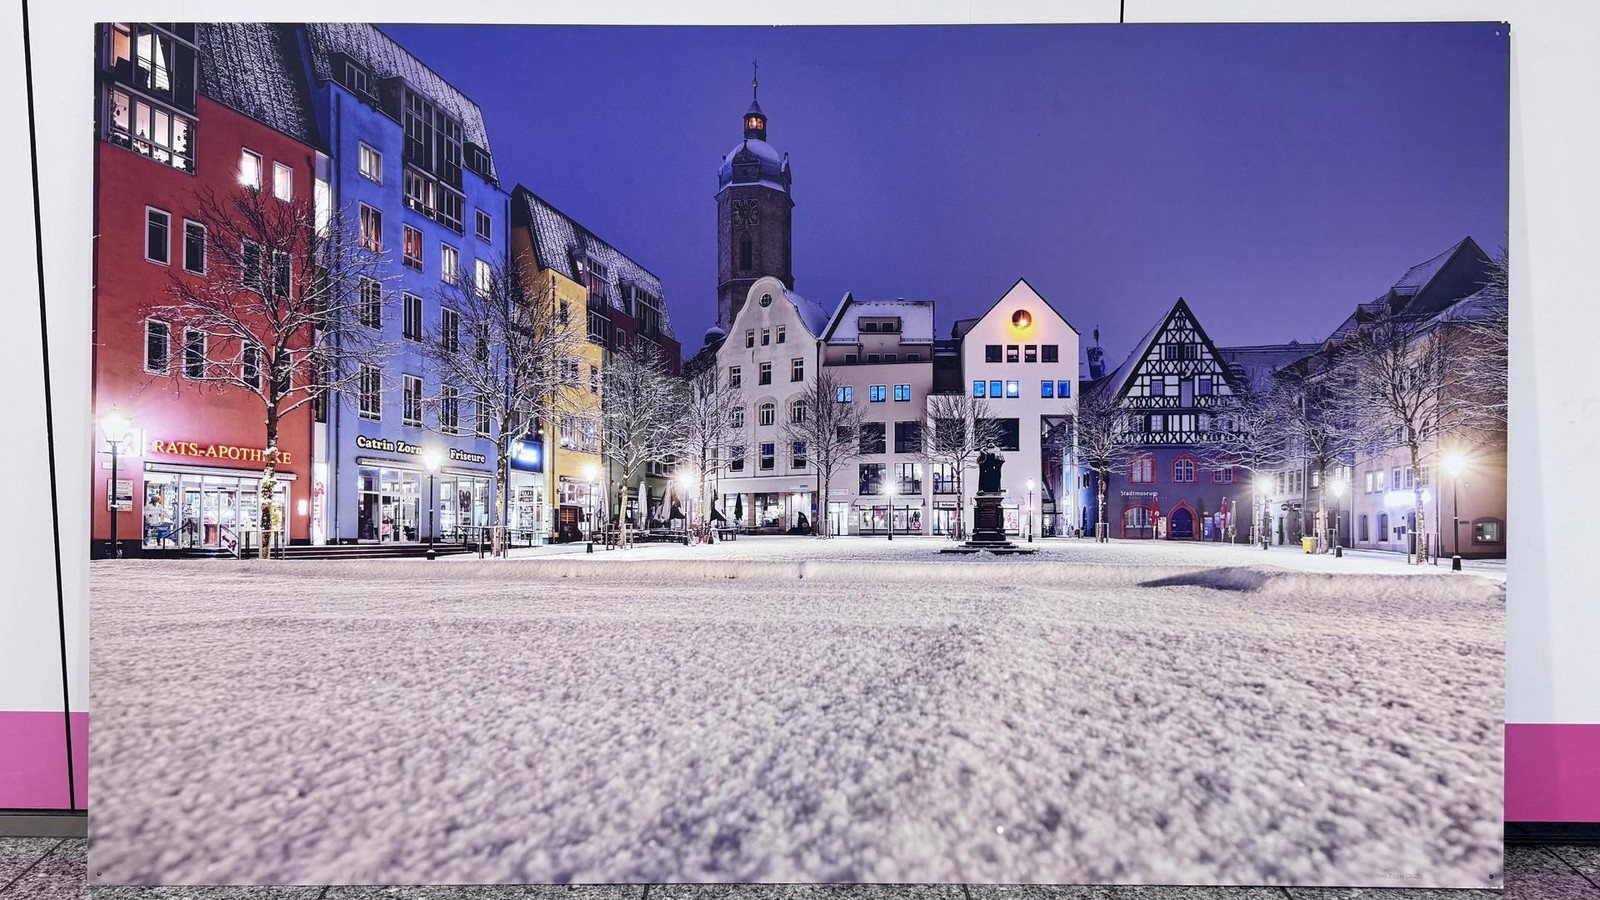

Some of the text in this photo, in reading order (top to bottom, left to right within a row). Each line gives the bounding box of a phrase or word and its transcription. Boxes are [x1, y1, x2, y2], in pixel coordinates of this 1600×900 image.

[357, 436, 485, 464] Catrin Zorn Friseure
